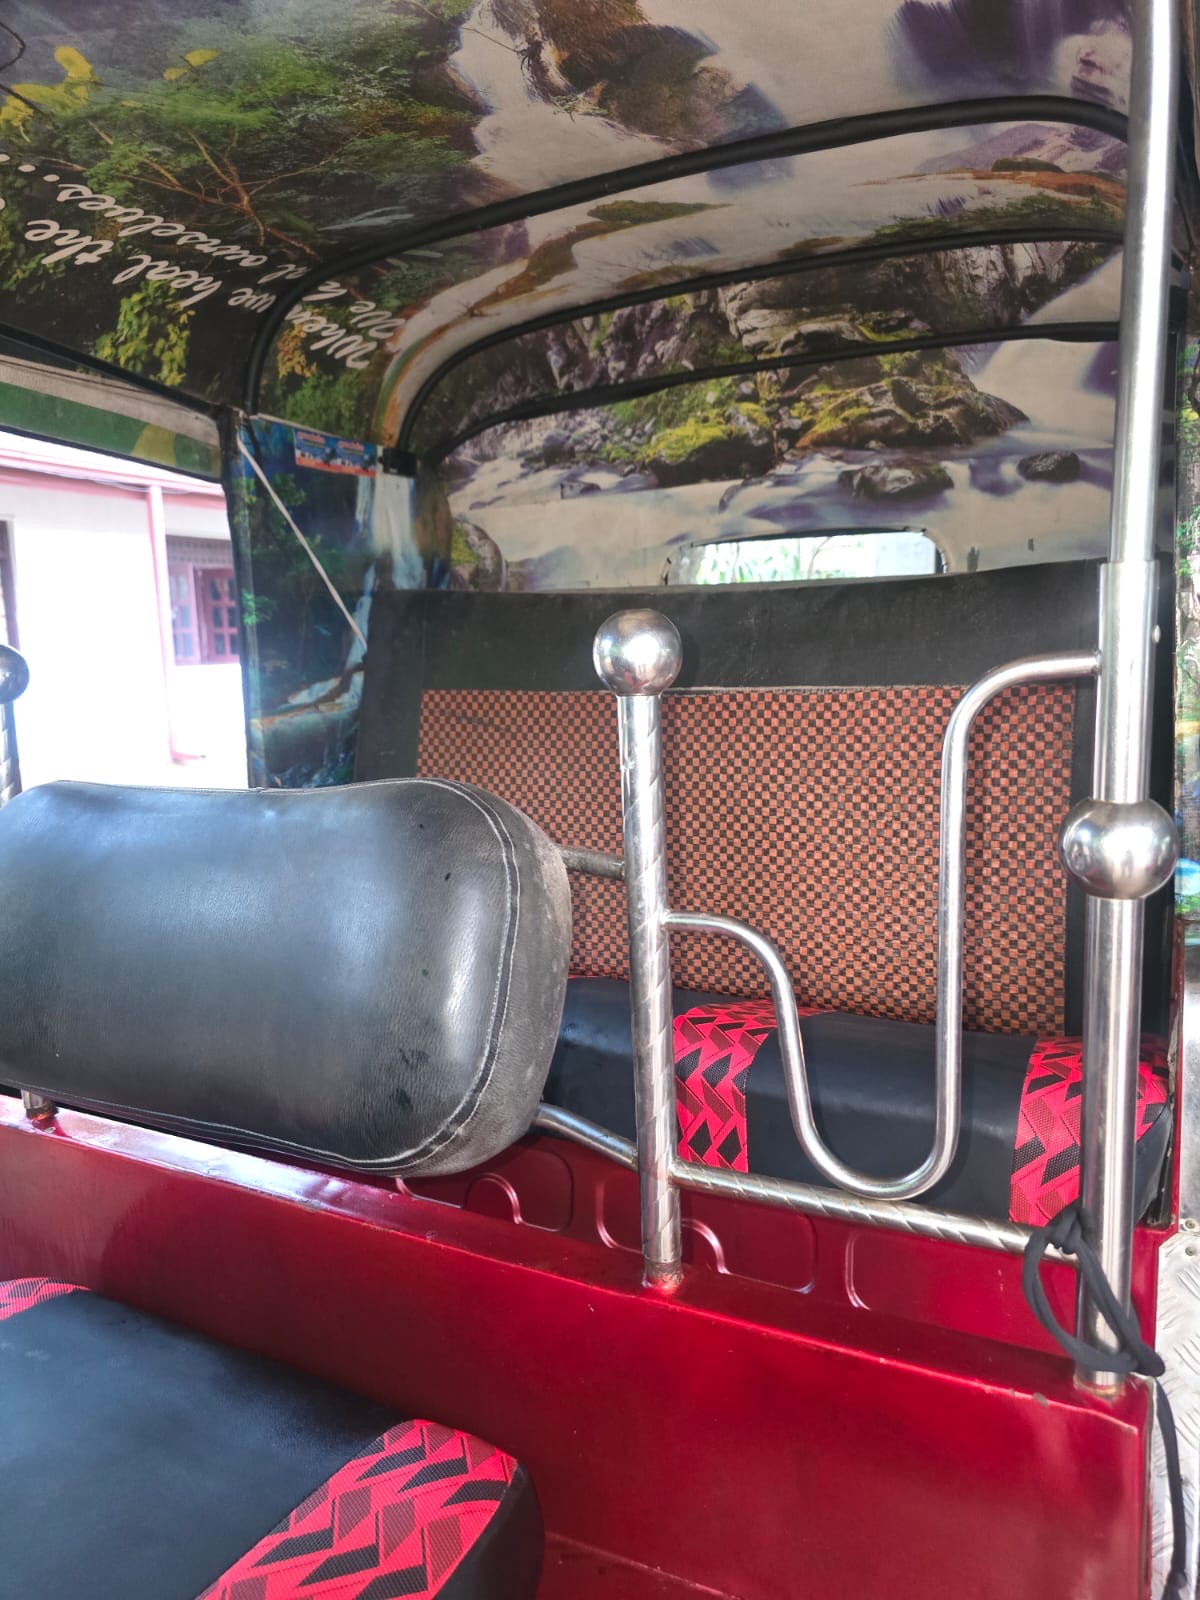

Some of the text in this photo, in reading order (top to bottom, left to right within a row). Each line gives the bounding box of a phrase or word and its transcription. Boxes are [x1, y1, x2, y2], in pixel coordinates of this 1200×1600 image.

[24, 219, 114, 265] the
[112, 254, 222, 307] heal
[228, 287, 276, 313] we
[257, 263, 348, 302] hal
[348, 300, 406, 339] We
